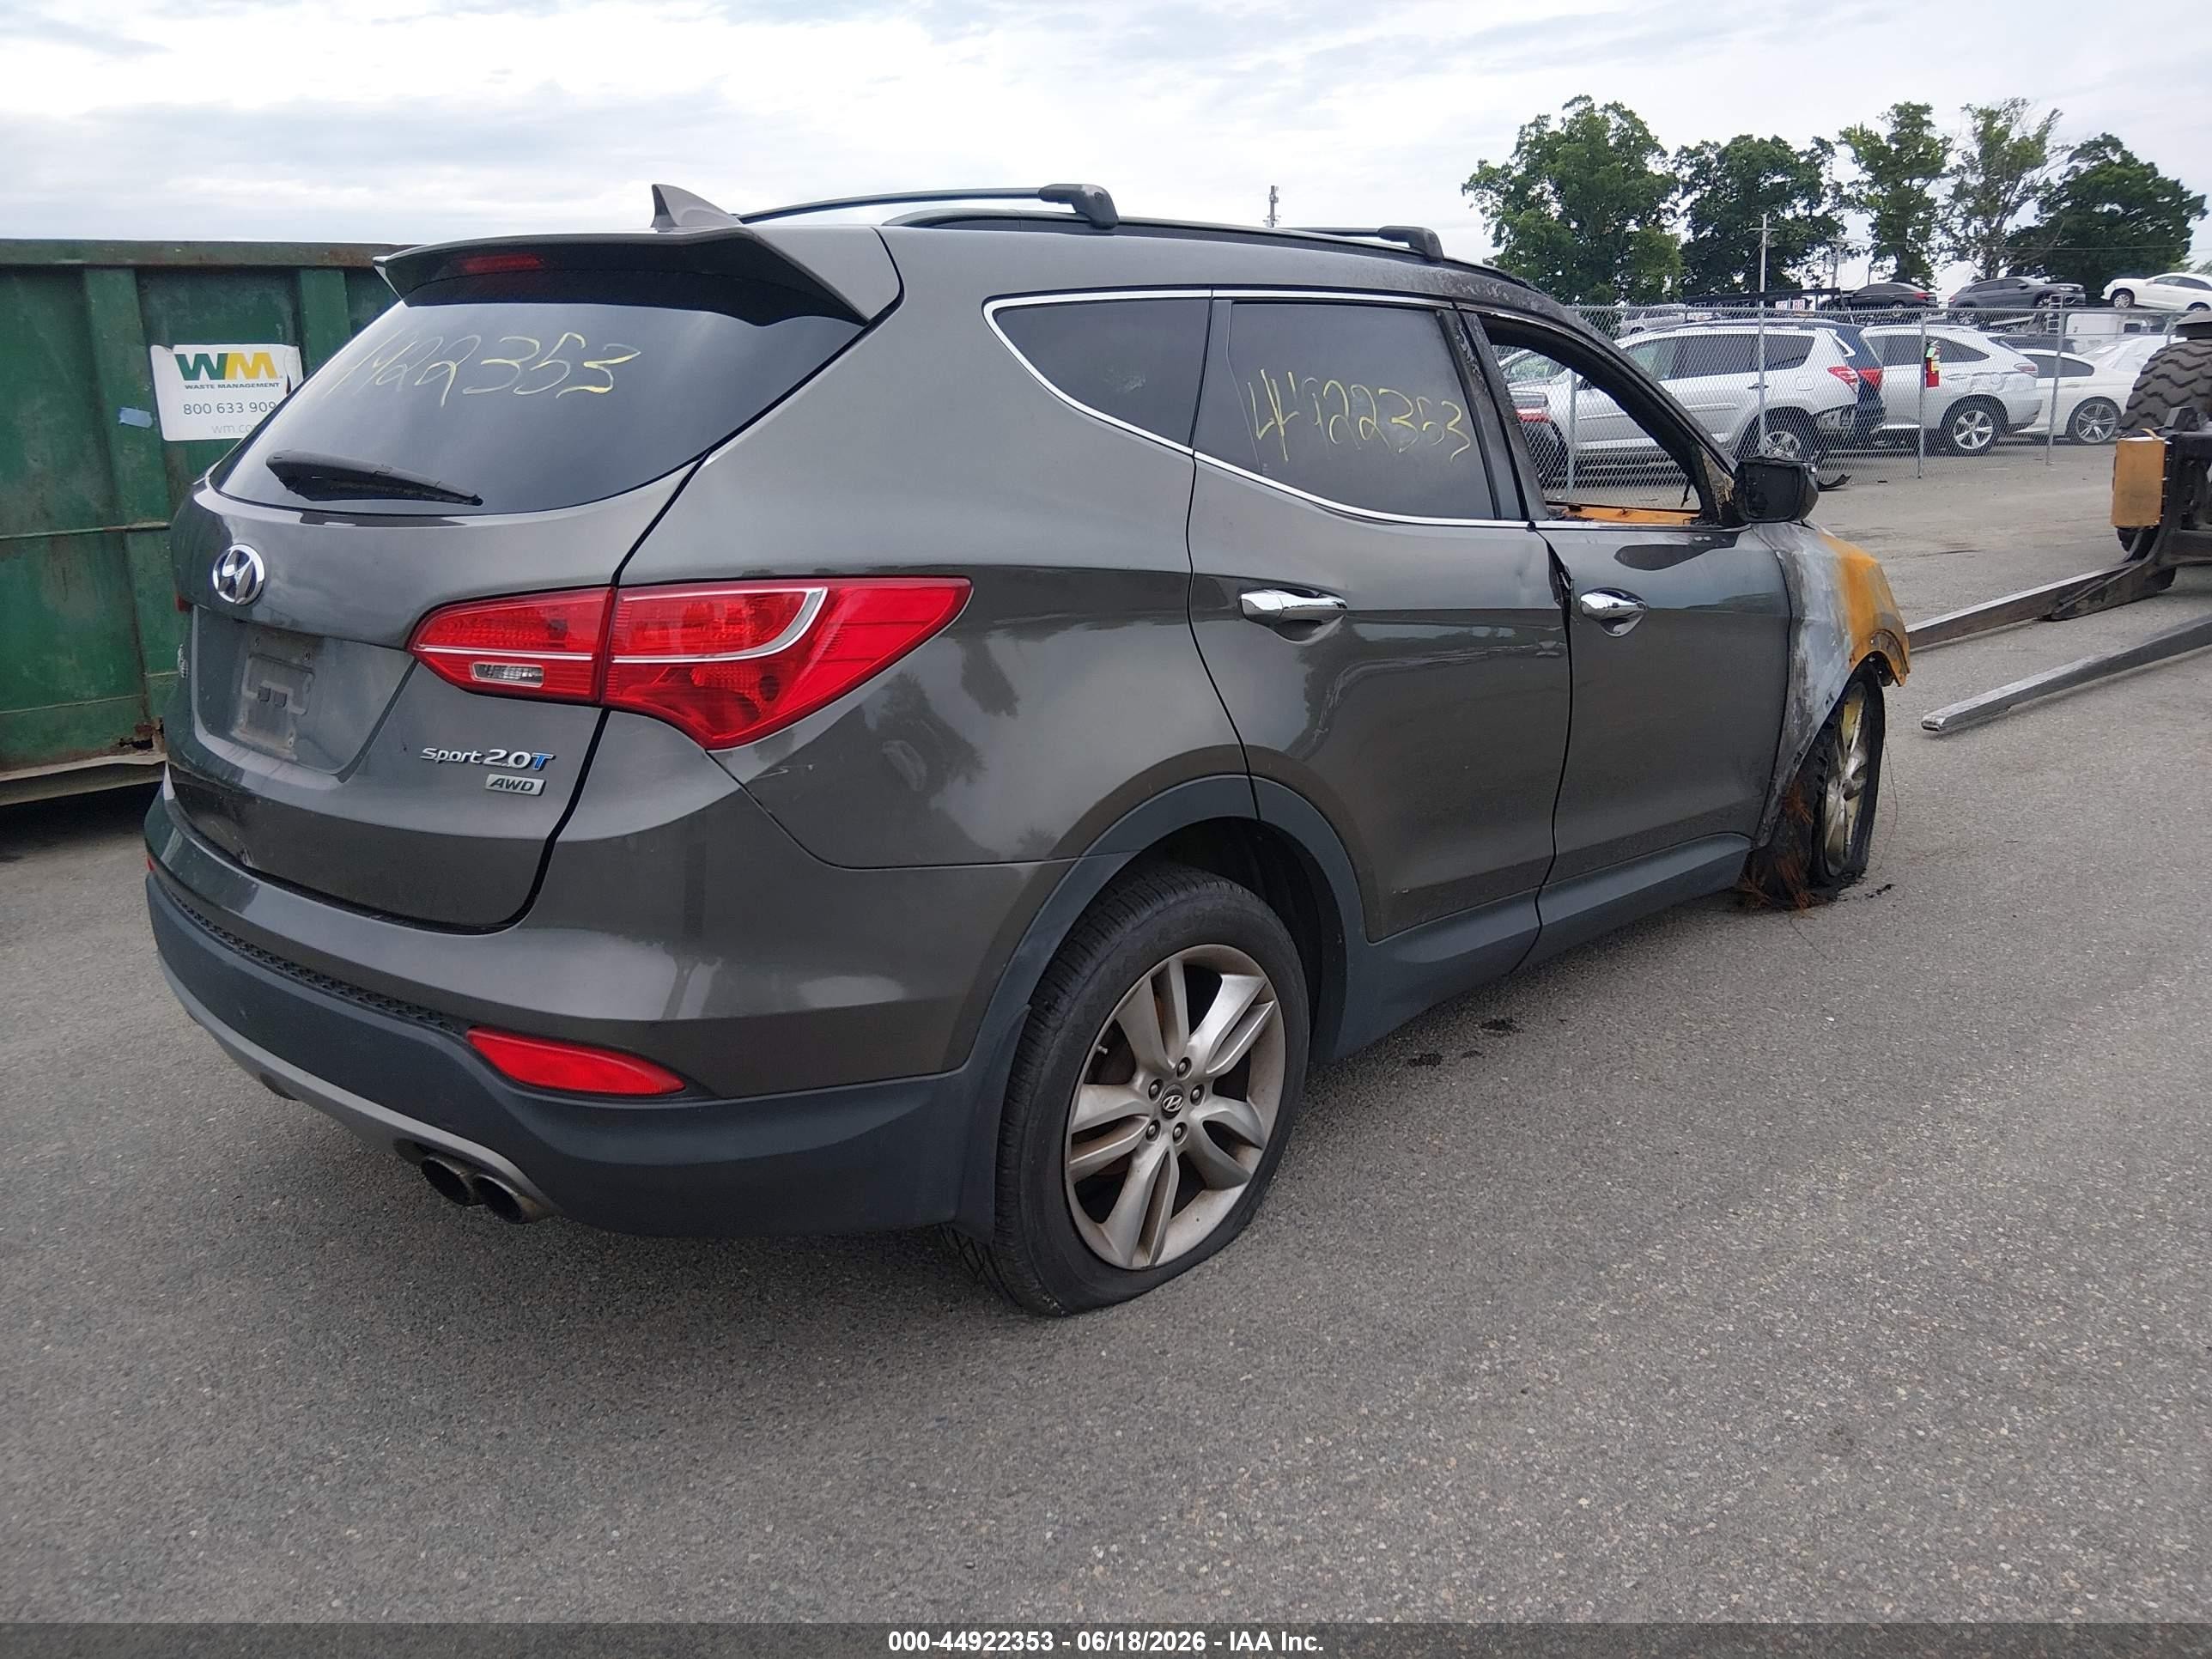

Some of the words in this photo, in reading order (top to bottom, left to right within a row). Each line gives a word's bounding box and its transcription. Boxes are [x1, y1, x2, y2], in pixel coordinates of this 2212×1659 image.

[174, 351, 278, 380] WM
[183, 404, 212, 415] 800
[216, 402, 245, 413] 633
[212, 423, 258, 433] wm.co
[489, 777, 535, 791] AWD
